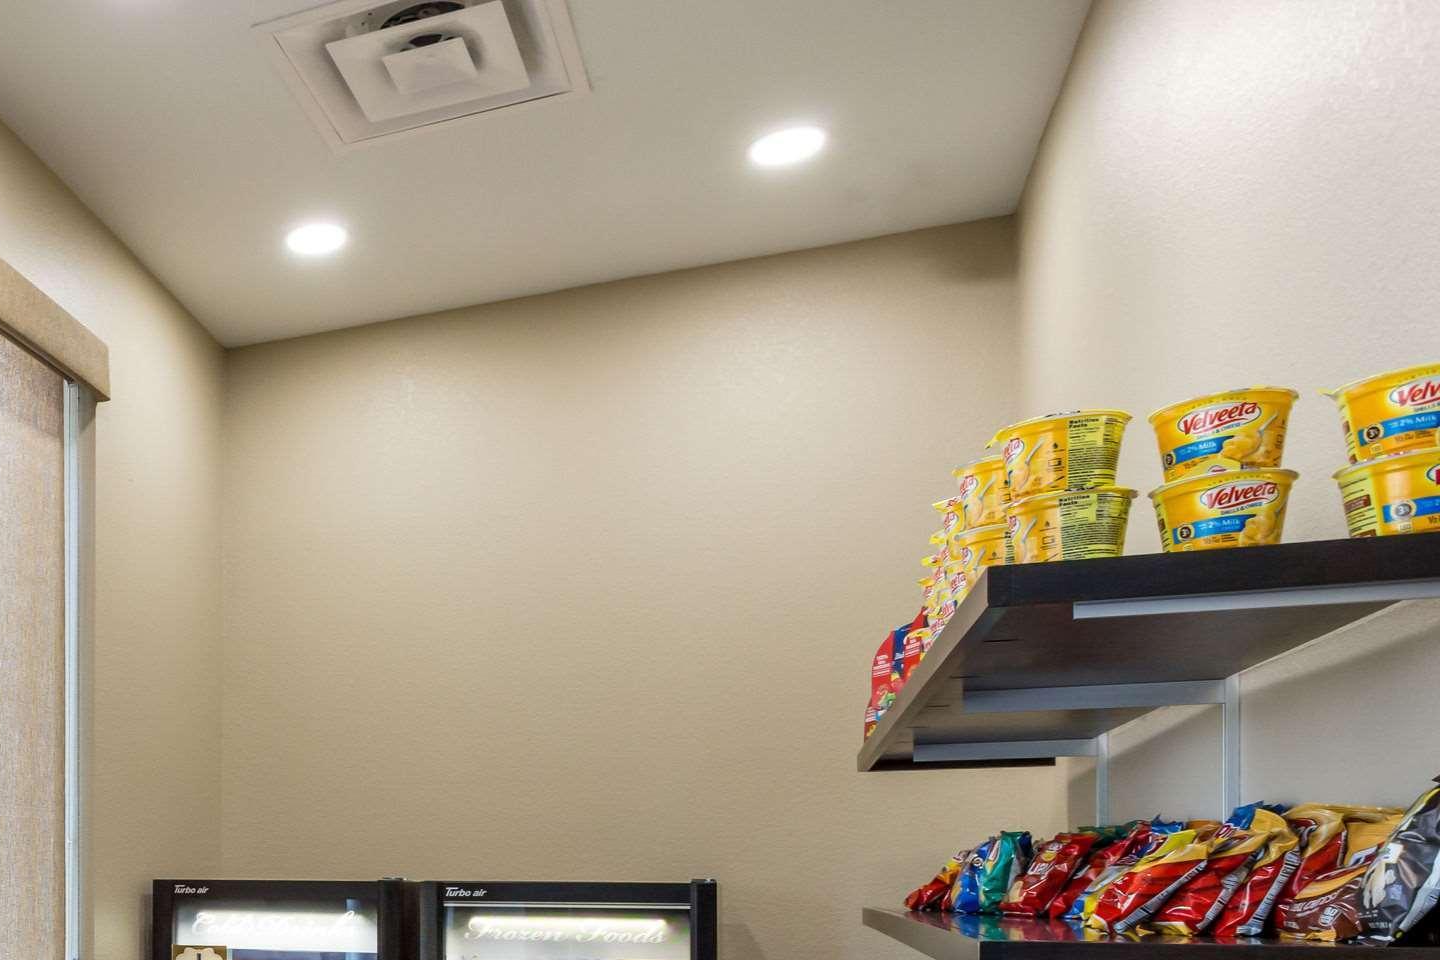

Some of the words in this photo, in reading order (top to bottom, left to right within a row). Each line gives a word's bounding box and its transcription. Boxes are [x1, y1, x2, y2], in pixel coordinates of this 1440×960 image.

[1398, 381, 1440, 407] Velv
[1183, 402, 1258, 435] Velveeta
[1208, 482, 1278, 509] Velveeta
[174, 884, 196, 894] Turbo
[197, 886, 210, 894] air
[445, 887, 471, 897] Turbo
[472, 889, 488, 897] air
